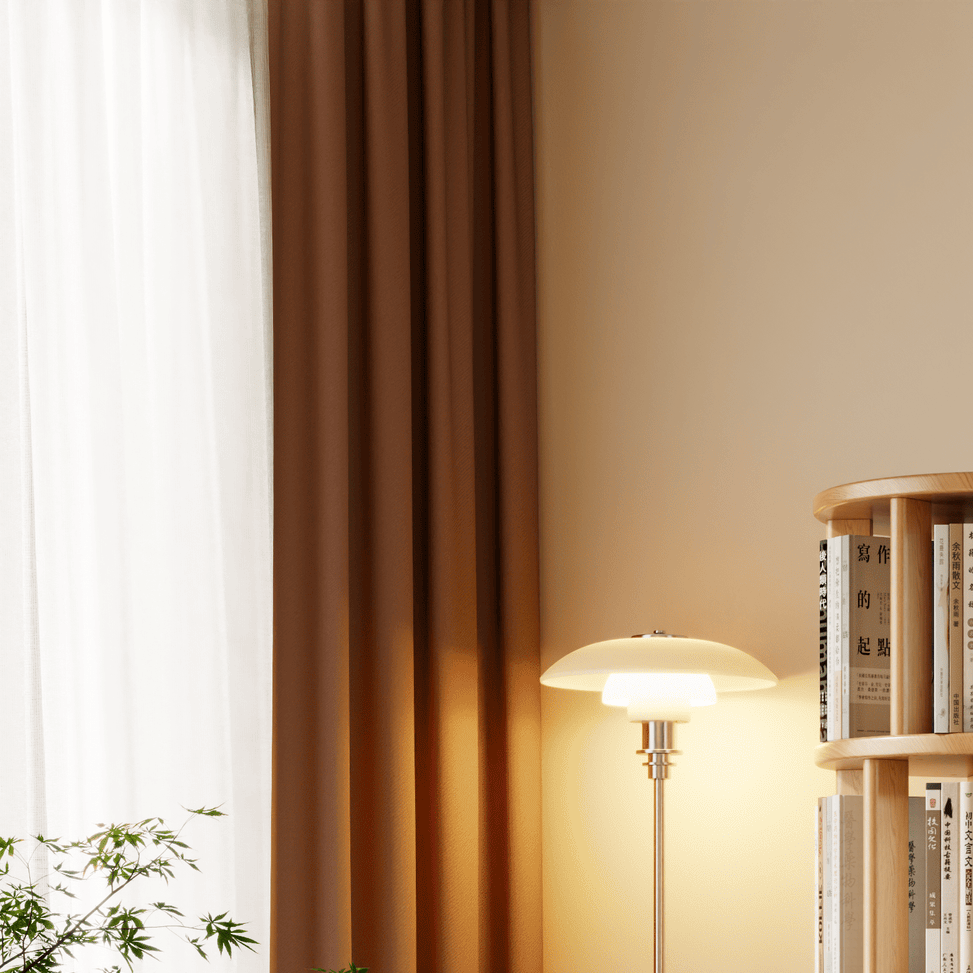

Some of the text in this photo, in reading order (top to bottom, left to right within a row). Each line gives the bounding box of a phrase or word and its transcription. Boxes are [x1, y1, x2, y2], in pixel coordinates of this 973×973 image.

[952, 542, 961, 590] 余秋雨散文
[857, 590, 871, 610] 的
[964, 812, 973, 867] 初中文言文
